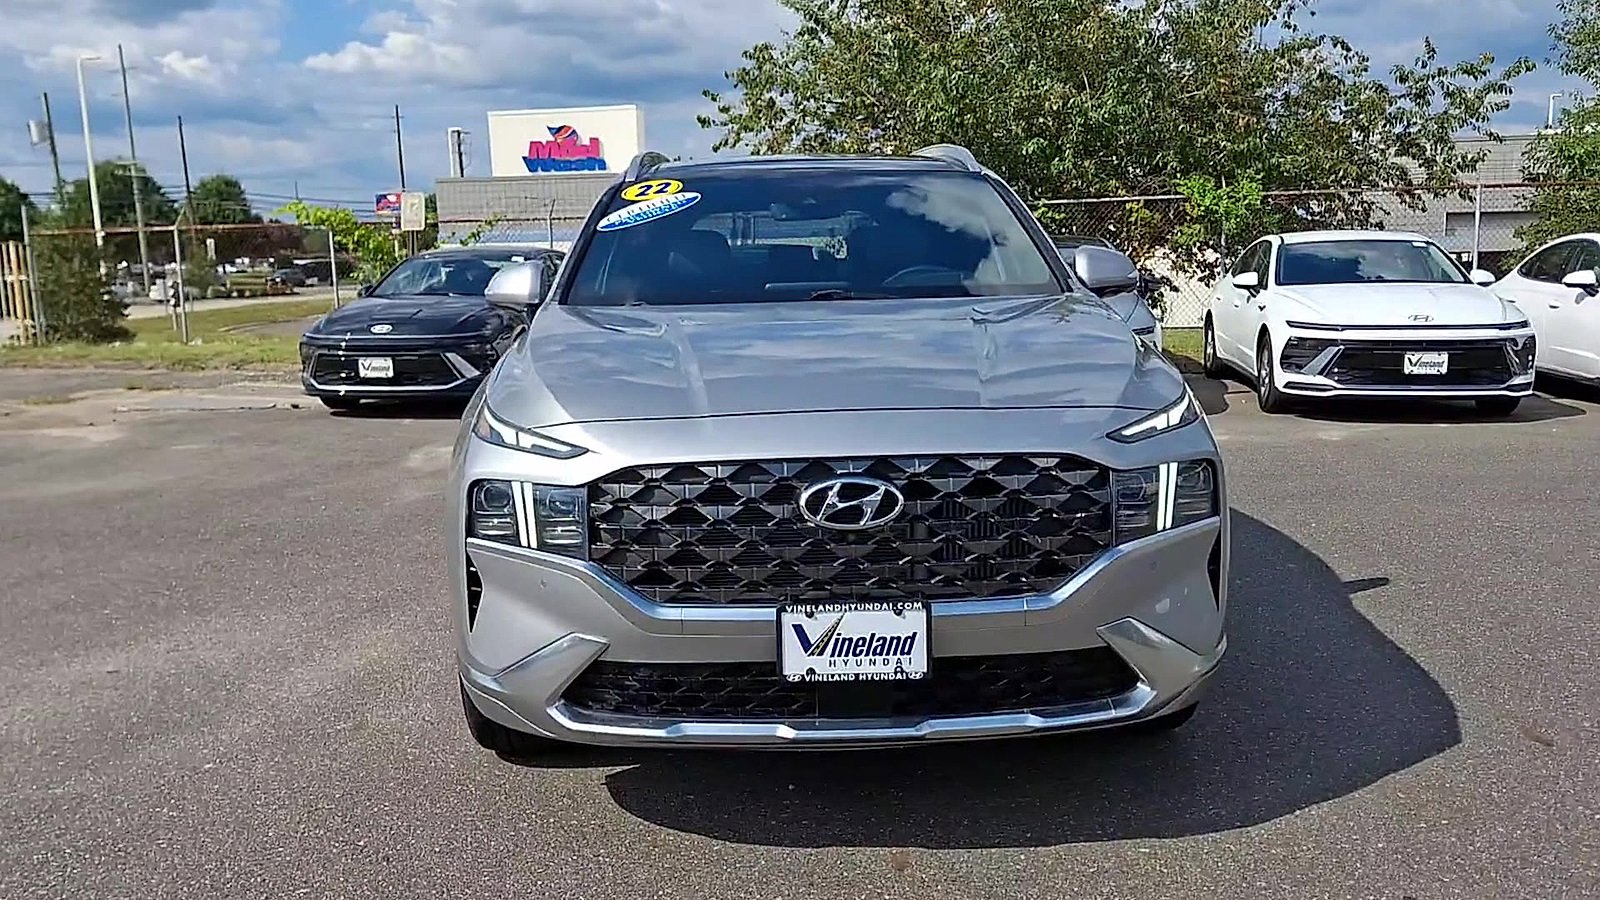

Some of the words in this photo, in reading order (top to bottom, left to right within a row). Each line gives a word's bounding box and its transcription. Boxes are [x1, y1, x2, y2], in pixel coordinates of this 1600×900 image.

[635, 182, 672, 197] 22
[786, 601, 923, 613] VINELANDHYUNDAI.COM
[791, 613, 918, 657] Vineland
[828, 657, 912, 668] HYUNDAI
[804, 673, 855, 682] VINELAND
[859, 672, 907, 681] HYUNDAI
